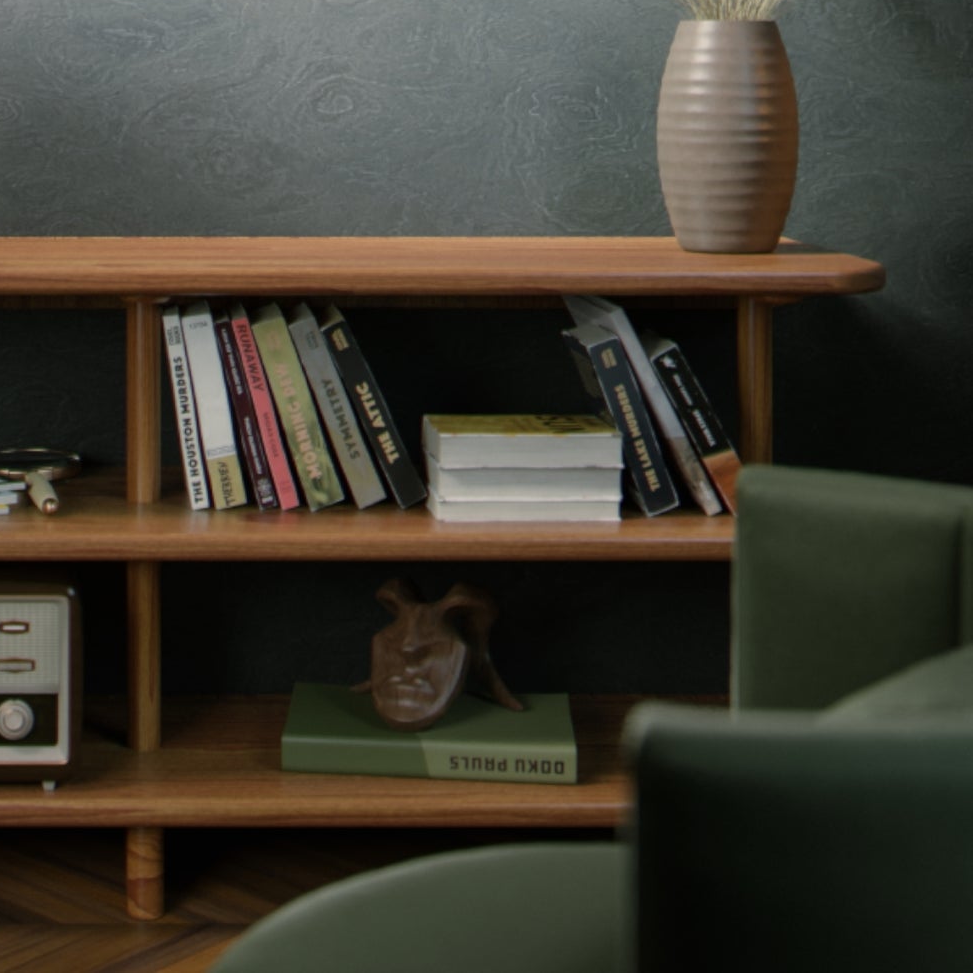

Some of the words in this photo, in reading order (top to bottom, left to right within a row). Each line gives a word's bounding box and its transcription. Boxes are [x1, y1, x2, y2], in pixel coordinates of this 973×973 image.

[237, 323, 265, 392] RUNAWAY
[276, 362, 296, 397] DEW
[173, 356, 190, 414] MURDERS
[355, 381, 386, 429] ATTIC
[323, 379, 361, 460] SYMMETRY
[613, 383, 642, 438] MURDERS
[182, 417, 200, 478] HOUSTON
[286, 402, 323, 480] MORNING
[376, 430, 400, 465] THE
[633, 438, 653, 469] LAKE
[190, 481, 204, 504] THE
[643, 467, 661, 493] THE
[515, 757, 565, 775] DOKU
